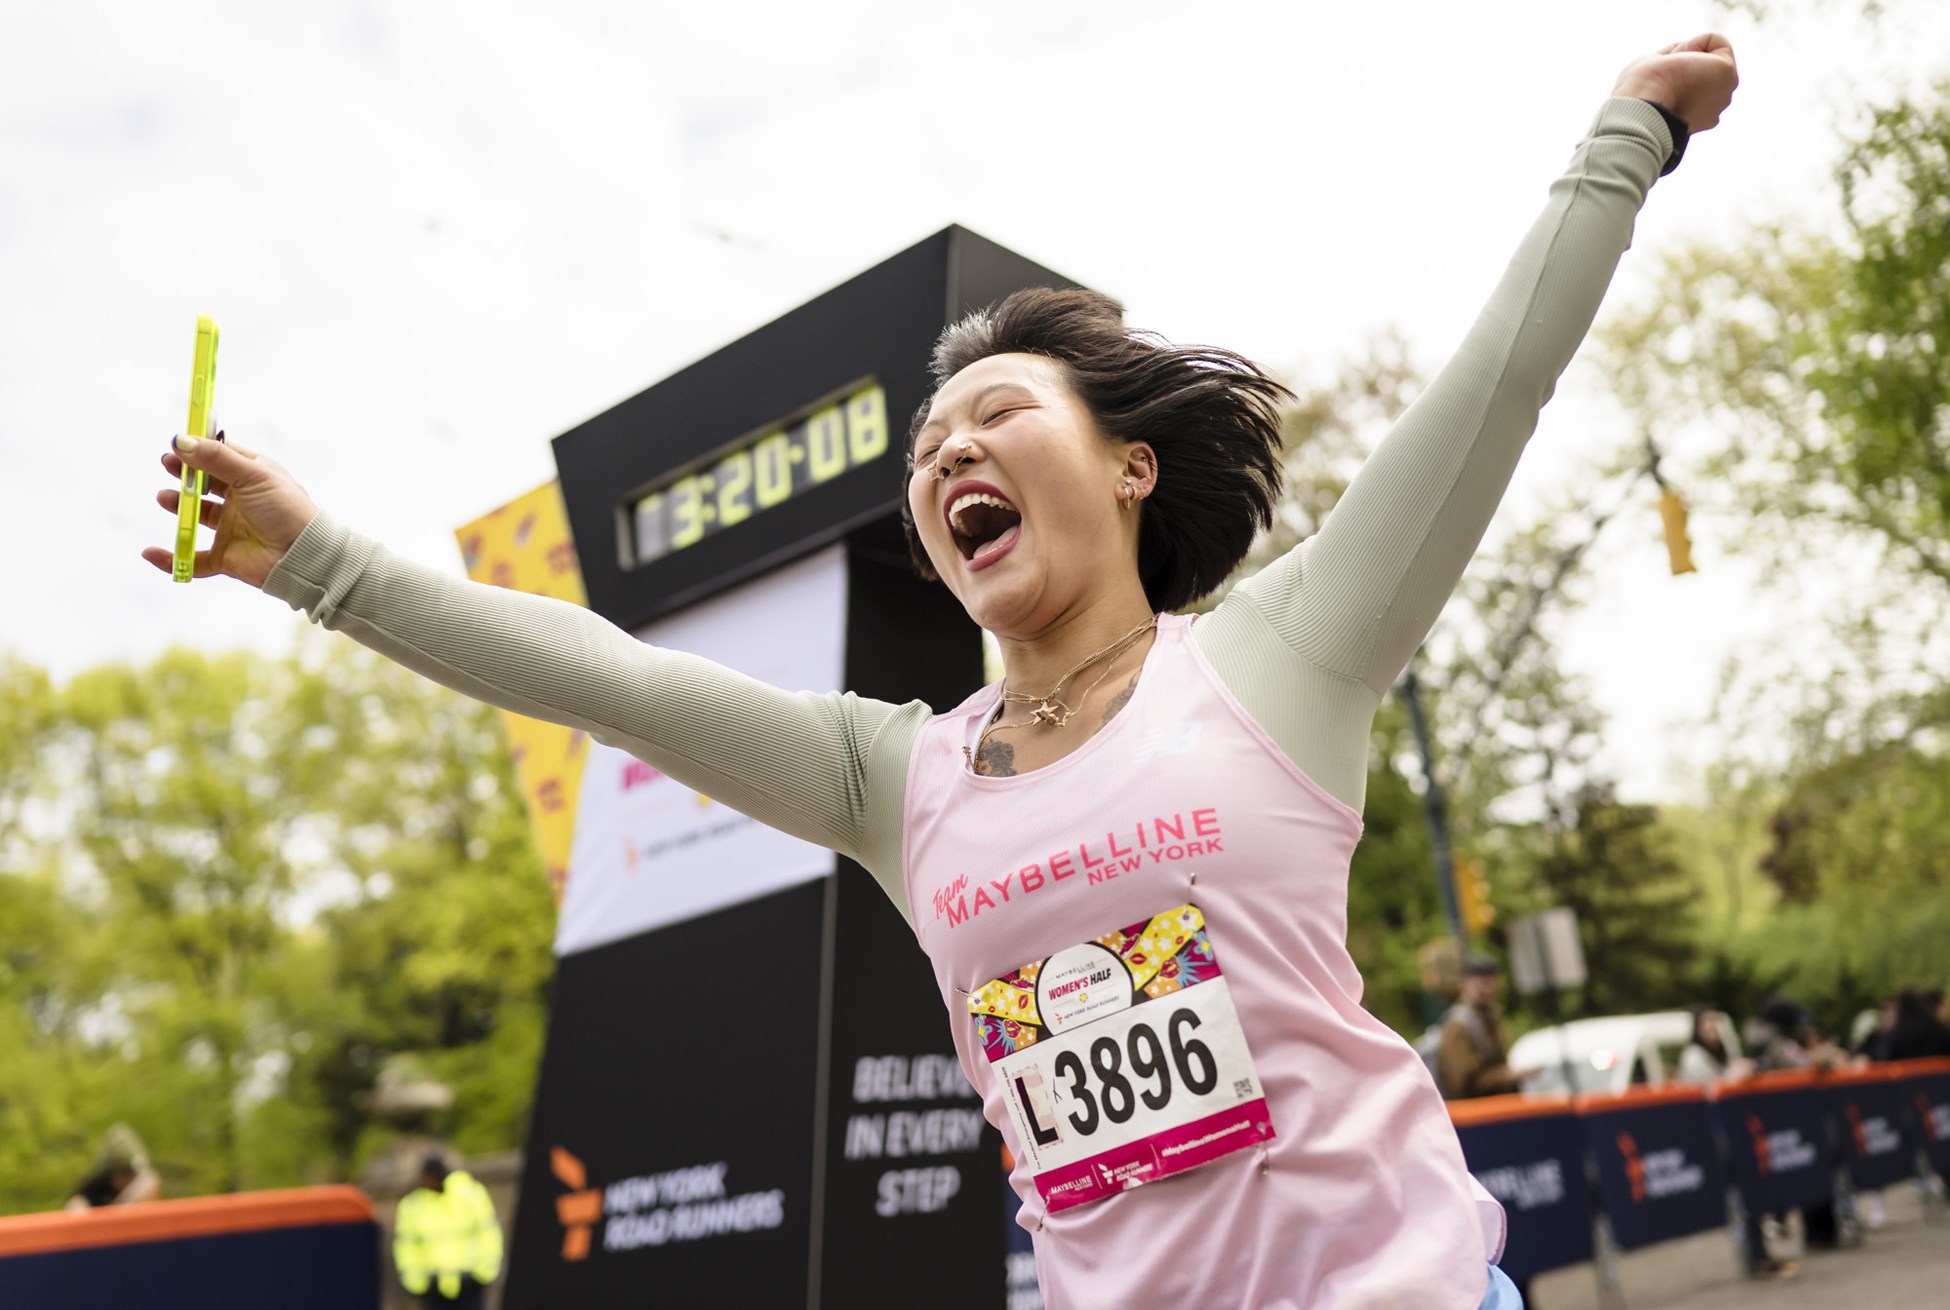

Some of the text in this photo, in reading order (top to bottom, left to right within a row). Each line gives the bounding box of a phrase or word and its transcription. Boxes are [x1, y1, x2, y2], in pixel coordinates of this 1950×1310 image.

[946, 808, 1221, 928] MAYBELLINE
[1088, 837, 1224, 886] NEW YORK
[933, 873, 968, 920] Team
[1048, 968, 1112, 1000] WOMEN'S HALF
[1054, 1008, 1217, 1136] 3896
[844, 1109, 986, 1159] IN EVERY
[1014, 1076, 1059, 1146] L
[605, 1162, 727, 1214] NEW YORK
[875, 1165, 961, 1216] STEP
[1050, 1175, 1093, 1194] MAYBELLINE
